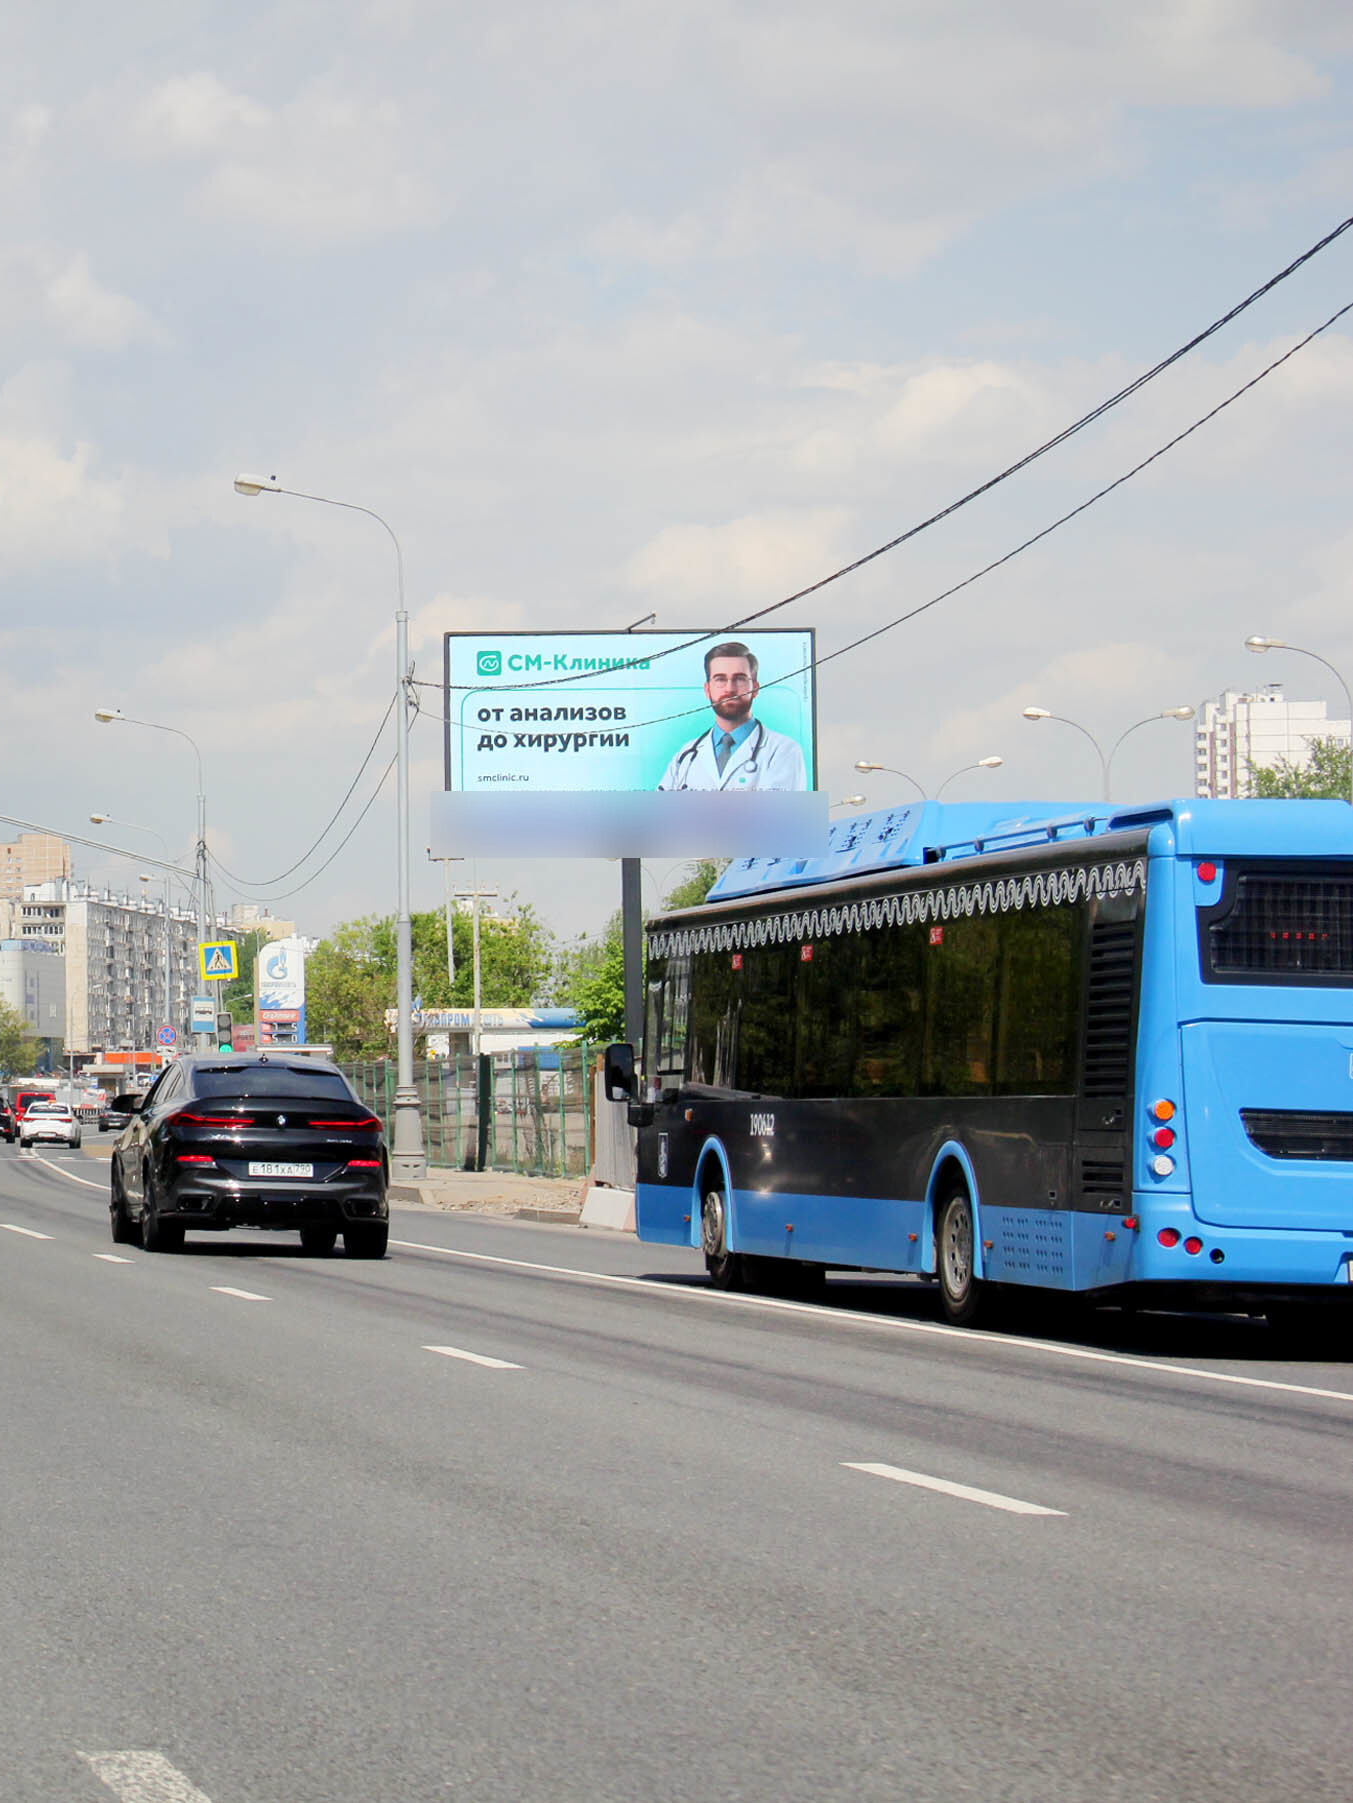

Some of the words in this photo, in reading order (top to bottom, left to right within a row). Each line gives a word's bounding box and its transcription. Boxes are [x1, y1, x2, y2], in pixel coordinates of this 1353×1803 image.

[507, 654, 650, 672] СМ-Клиника
[477, 708, 504, 722] от
[510, 706, 627, 722] анализов
[477, 734, 507, 751] до
[513, 732, 630, 752] хирургии
[477, 773, 529, 783] smclinic.ru
[750, 1113, 775, 1136] 190612
